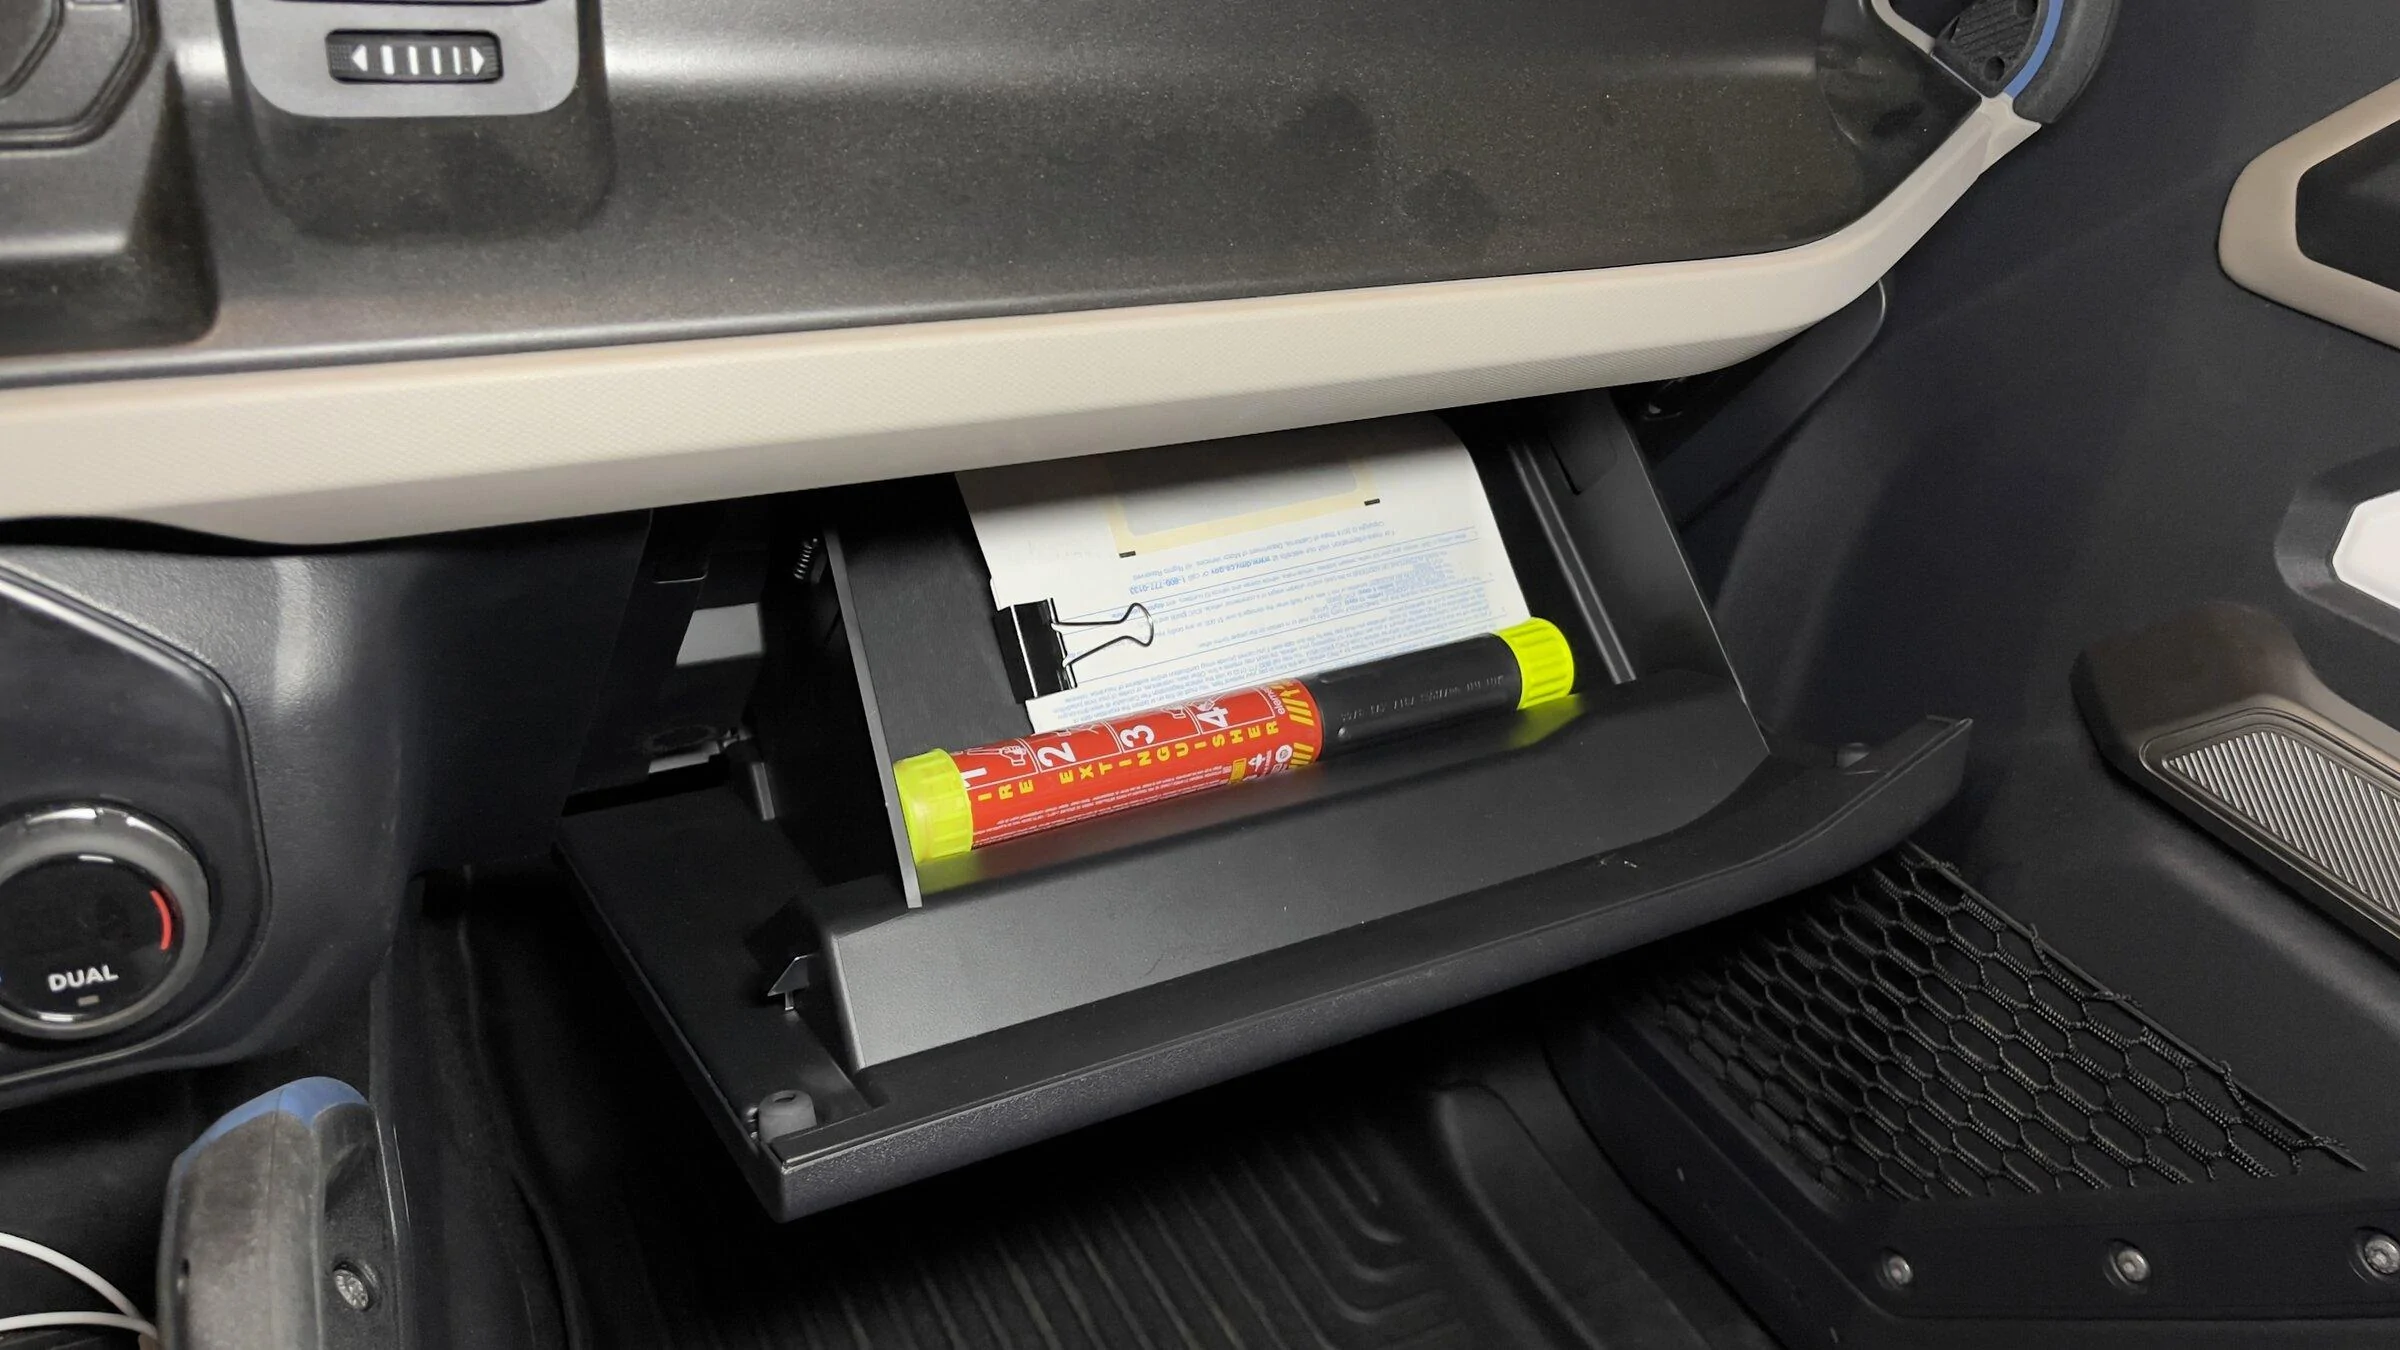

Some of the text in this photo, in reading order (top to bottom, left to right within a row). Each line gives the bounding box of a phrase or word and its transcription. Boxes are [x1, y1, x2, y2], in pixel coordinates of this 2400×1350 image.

[1210, 557, 1270, 573] www.dmv.ca.gov
[1128, 576, 1185, 593] 1-800-777-0133
[1198, 704, 1230, 730] 4
[1119, 723, 1156, 750] 3
[977, 778, 1035, 802] IRE
[1058, 720, 1280, 785] EXTINGUISHER
[1037, 741, 1076, 768] 2
[47, 963, 120, 992] DUAL
